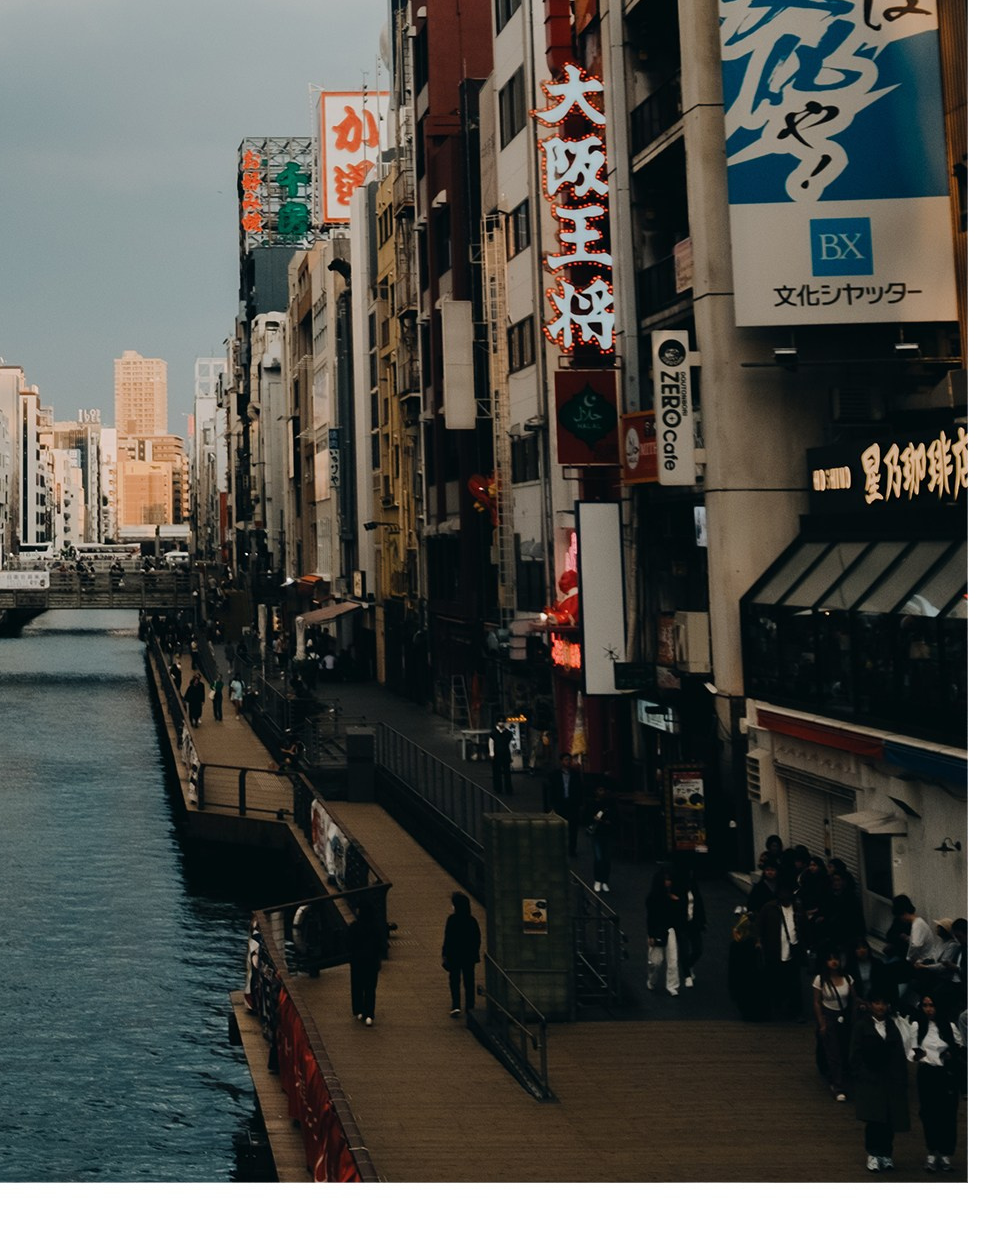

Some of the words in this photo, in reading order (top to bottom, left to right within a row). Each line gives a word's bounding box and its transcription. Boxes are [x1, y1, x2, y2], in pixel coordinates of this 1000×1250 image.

[534, 64, 615, 351] 大阪王将
[819, 232, 866, 262] BX
[660, 371, 682, 428] ZERO
